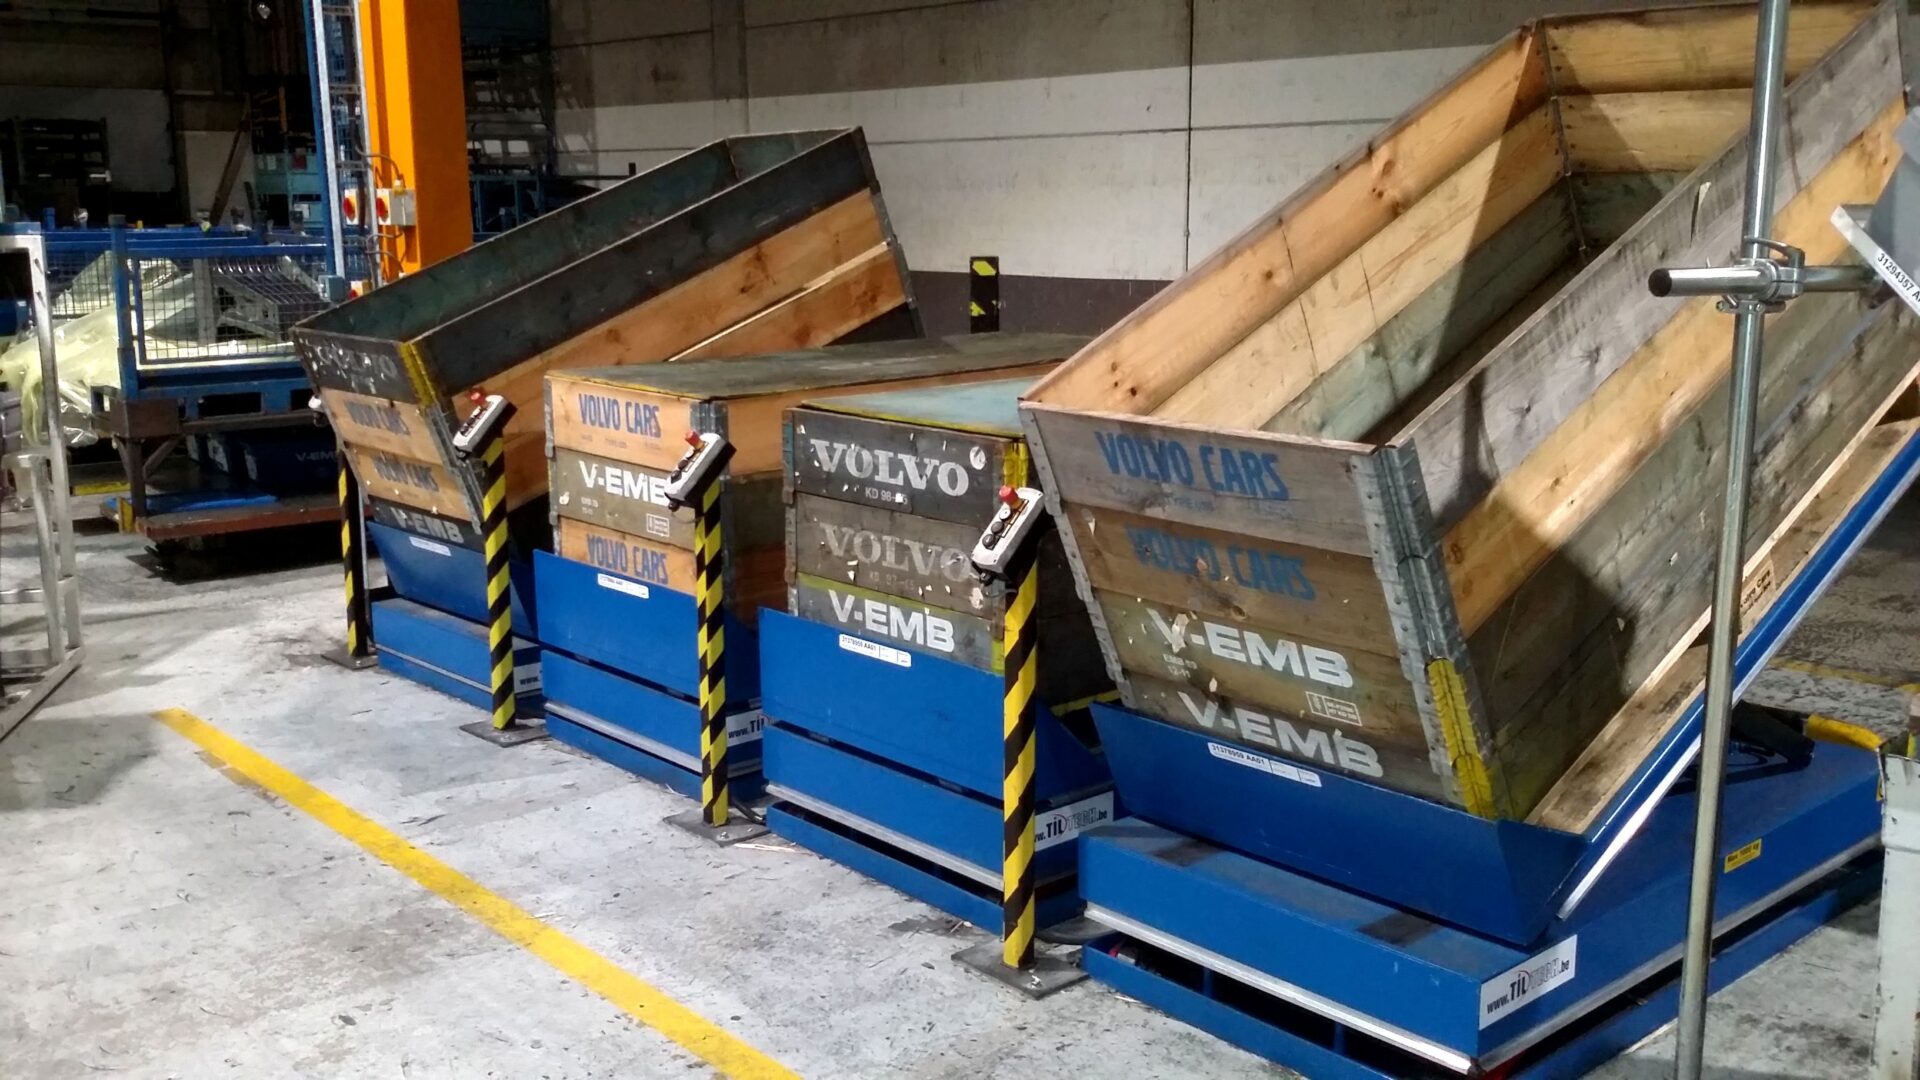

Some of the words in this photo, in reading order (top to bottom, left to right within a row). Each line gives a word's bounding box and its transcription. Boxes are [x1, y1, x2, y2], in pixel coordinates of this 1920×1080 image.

[1878, 253, 1914, 291] 31294357
[579, 393, 621, 431] VOLVO
[625, 402, 661, 438] CARS
[810, 438, 969, 497] VOLVO
[865, 487, 879, 499] KD
[1095, 430, 1195, 487] VOLVO
[1201, 445, 1289, 501] CARS
[587, 533, 629, 573] VOLVO
[632, 545, 669, 585] CARS
[819, 522, 972, 583] VOLVO
[1124, 525, 1222, 582] VOLVO
[1226, 544, 1317, 600] CARS
[828, 589, 956, 653] V-EMB
[1147, 607, 1353, 688] V-EMB
[1177, 690, 1384, 778] V-EMB
